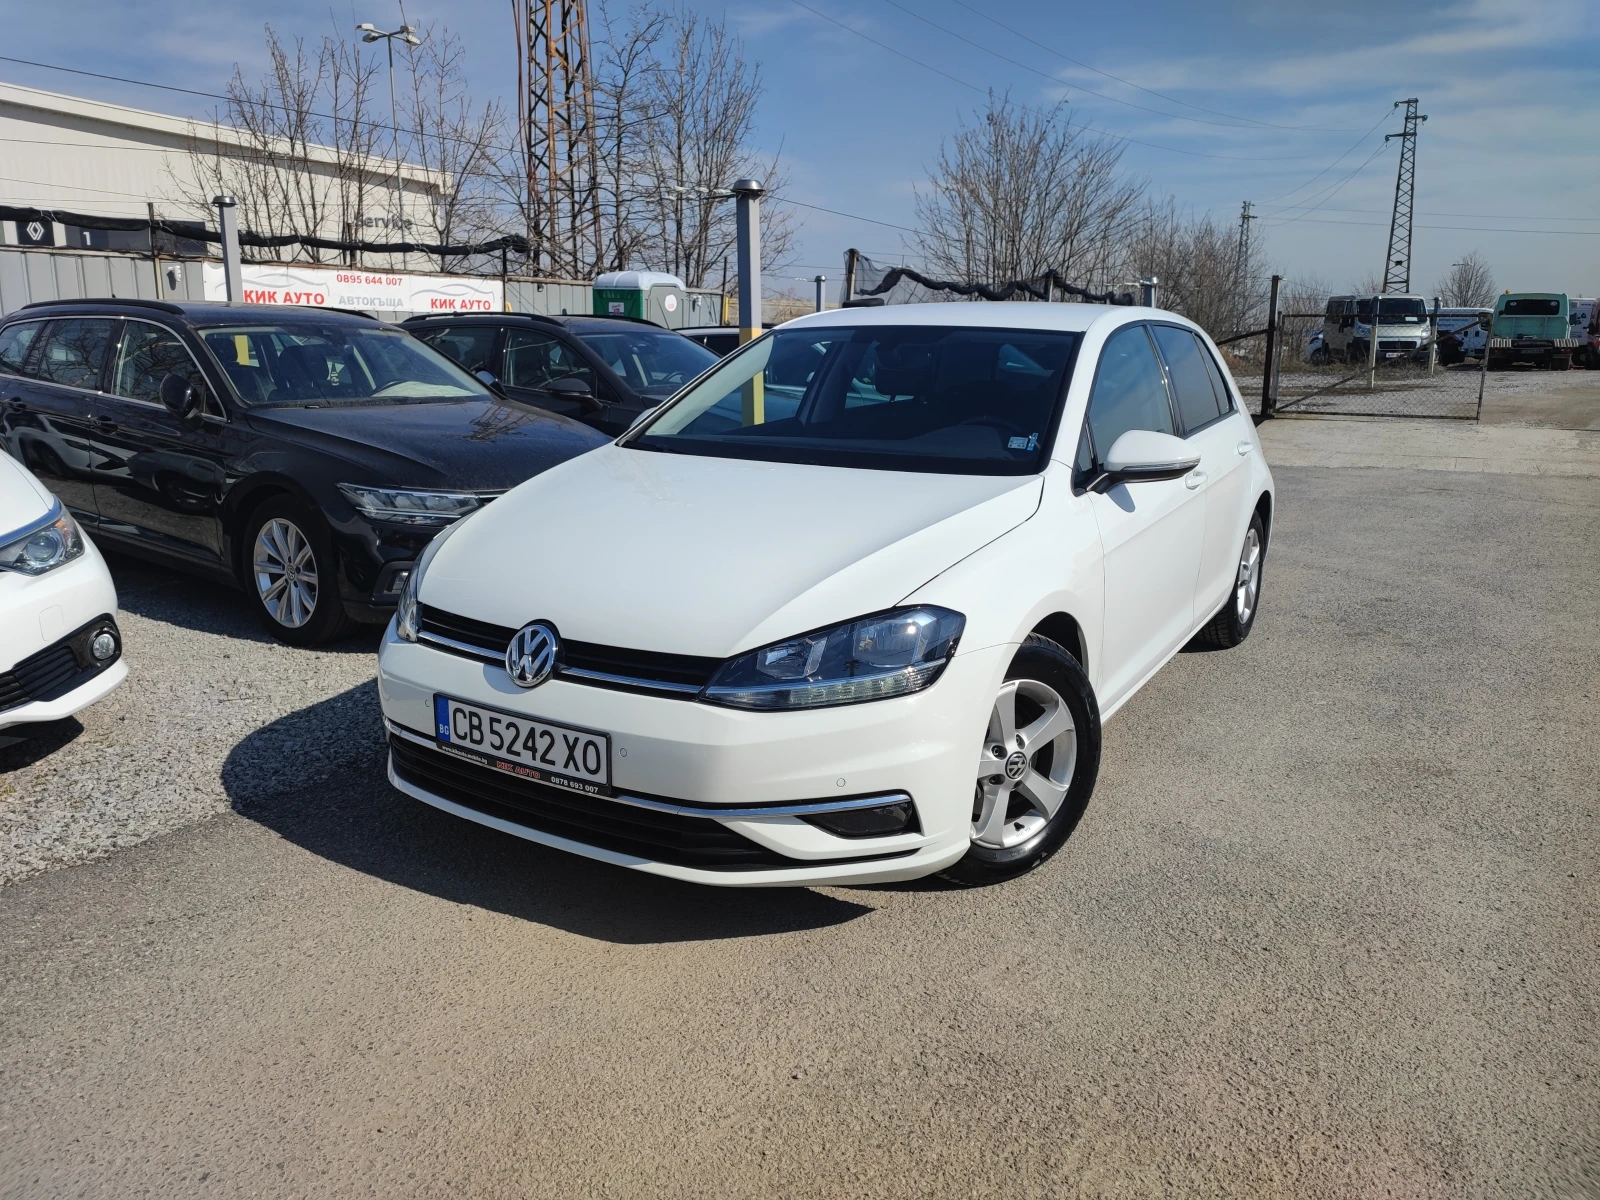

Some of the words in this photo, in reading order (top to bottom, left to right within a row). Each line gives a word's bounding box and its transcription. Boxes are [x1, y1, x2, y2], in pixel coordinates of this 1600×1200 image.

[83, 231, 91, 246] 1
[336, 274, 362, 283] 0895
[365, 275, 383, 285] 644
[385, 277, 403, 286] 007
[243, 289, 277, 304] КИК
[283, 291, 325, 305] АУТО
[338, 295, 403, 307] АВТОКЪЩА
[430, 298, 455, 310] КИК
[460, 300, 491, 311] АУТО
[439, 723, 450, 736] BG
[550, 776, 568, 786] 0878
[569, 781, 583, 790] 693
[584, 784, 599, 793] 007
